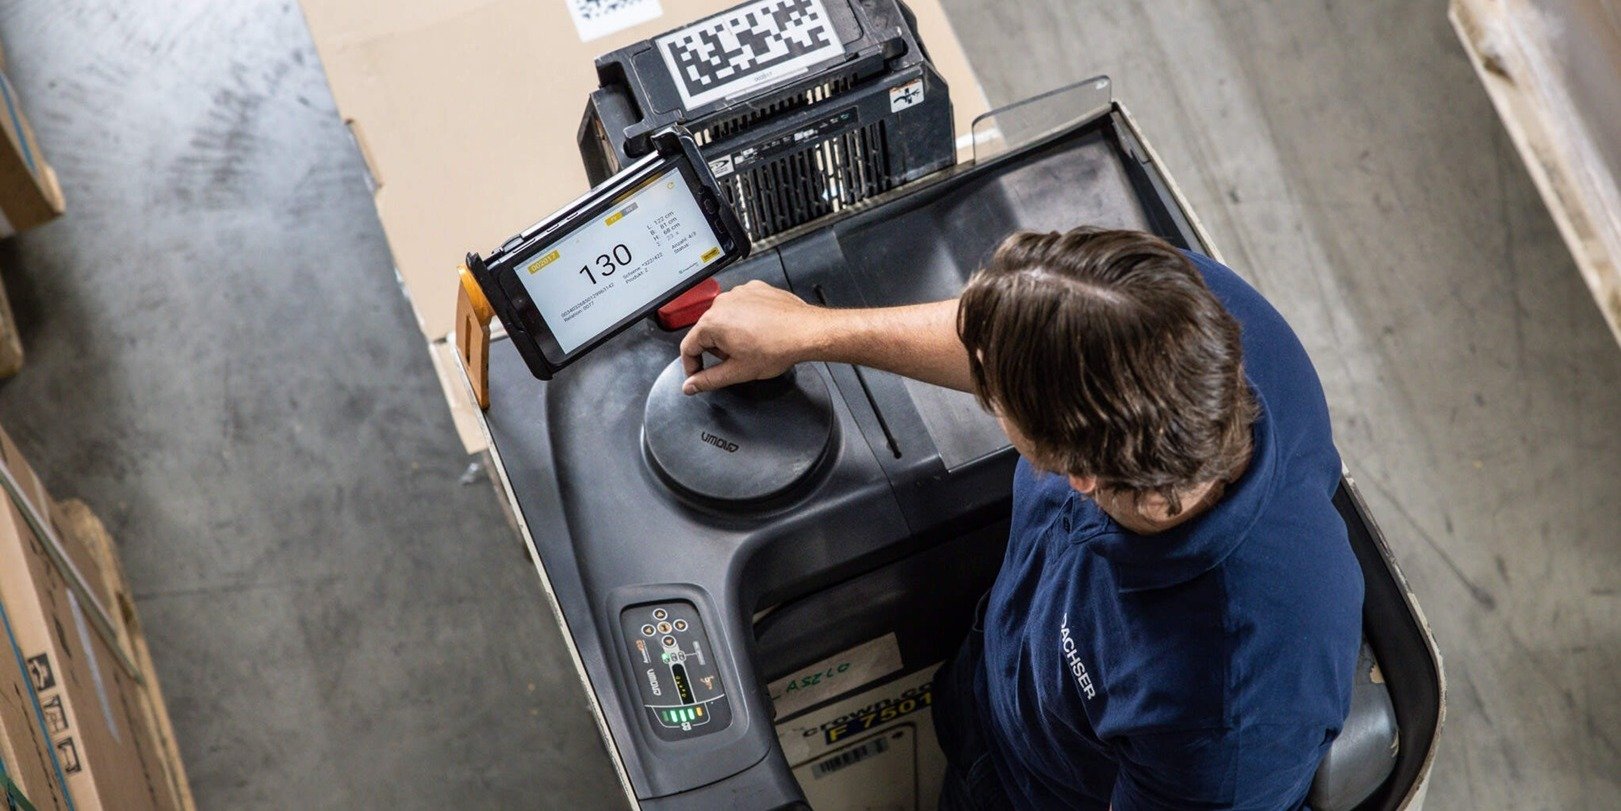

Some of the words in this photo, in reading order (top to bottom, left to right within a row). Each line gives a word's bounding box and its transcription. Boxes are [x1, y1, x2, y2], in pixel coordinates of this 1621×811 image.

[654, 216, 665, 225] 122
[665, 211, 674, 219] cm
[668, 217, 677, 225] cm
[578, 243, 631, 284] 130
[702, 432, 739, 453] CROWN
[647, 668, 661, 696] CROWN
[829, 727, 848, 742] F
[861, 692, 932, 729] 7501
